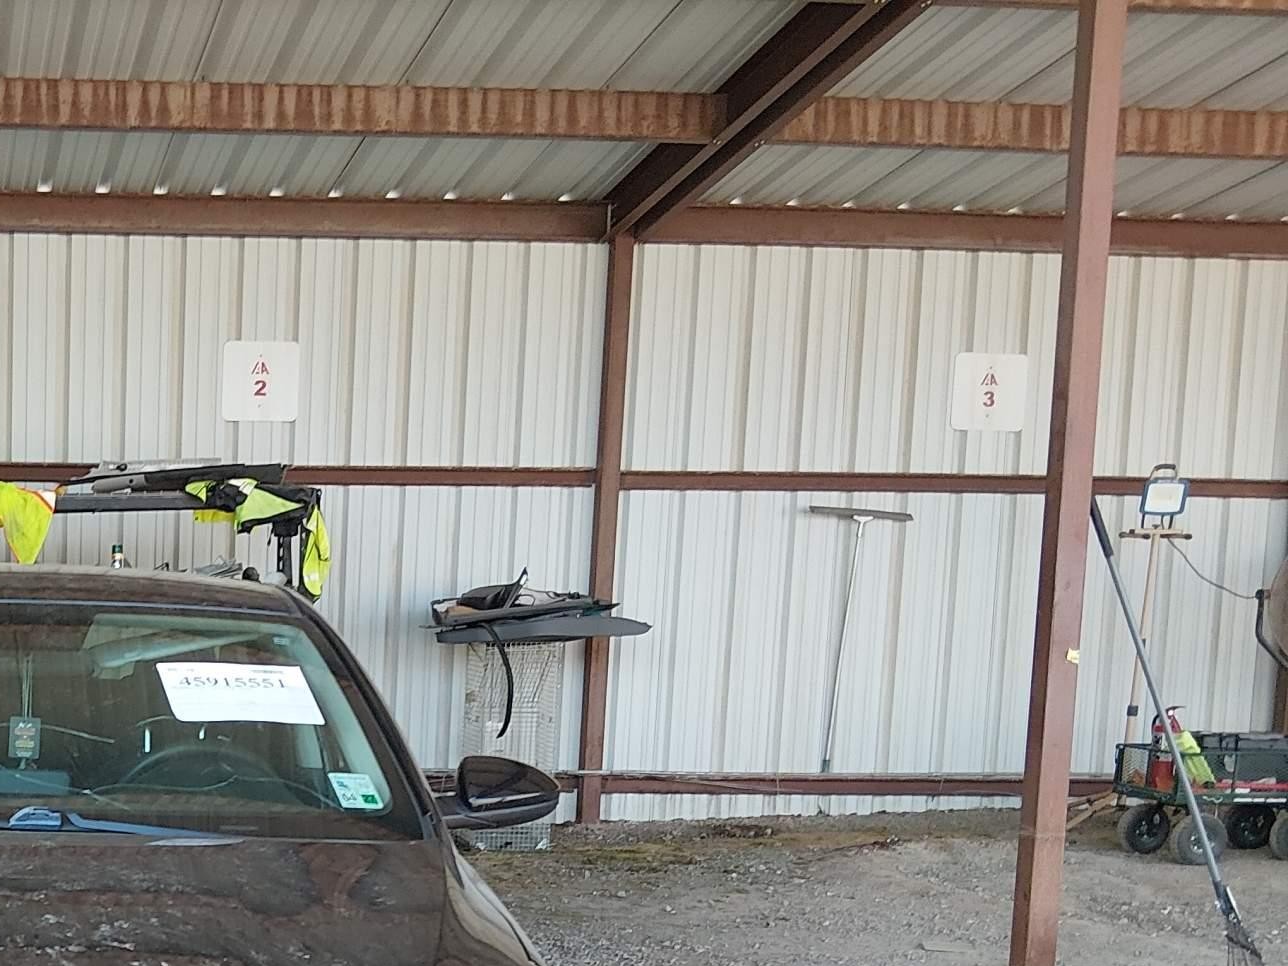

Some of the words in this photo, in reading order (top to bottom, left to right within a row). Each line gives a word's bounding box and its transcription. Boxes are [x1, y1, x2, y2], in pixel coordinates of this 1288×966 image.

[254, 380, 267, 396] 2
[983, 391, 995, 407] 3
[179, 676, 286, 688] 45915551
